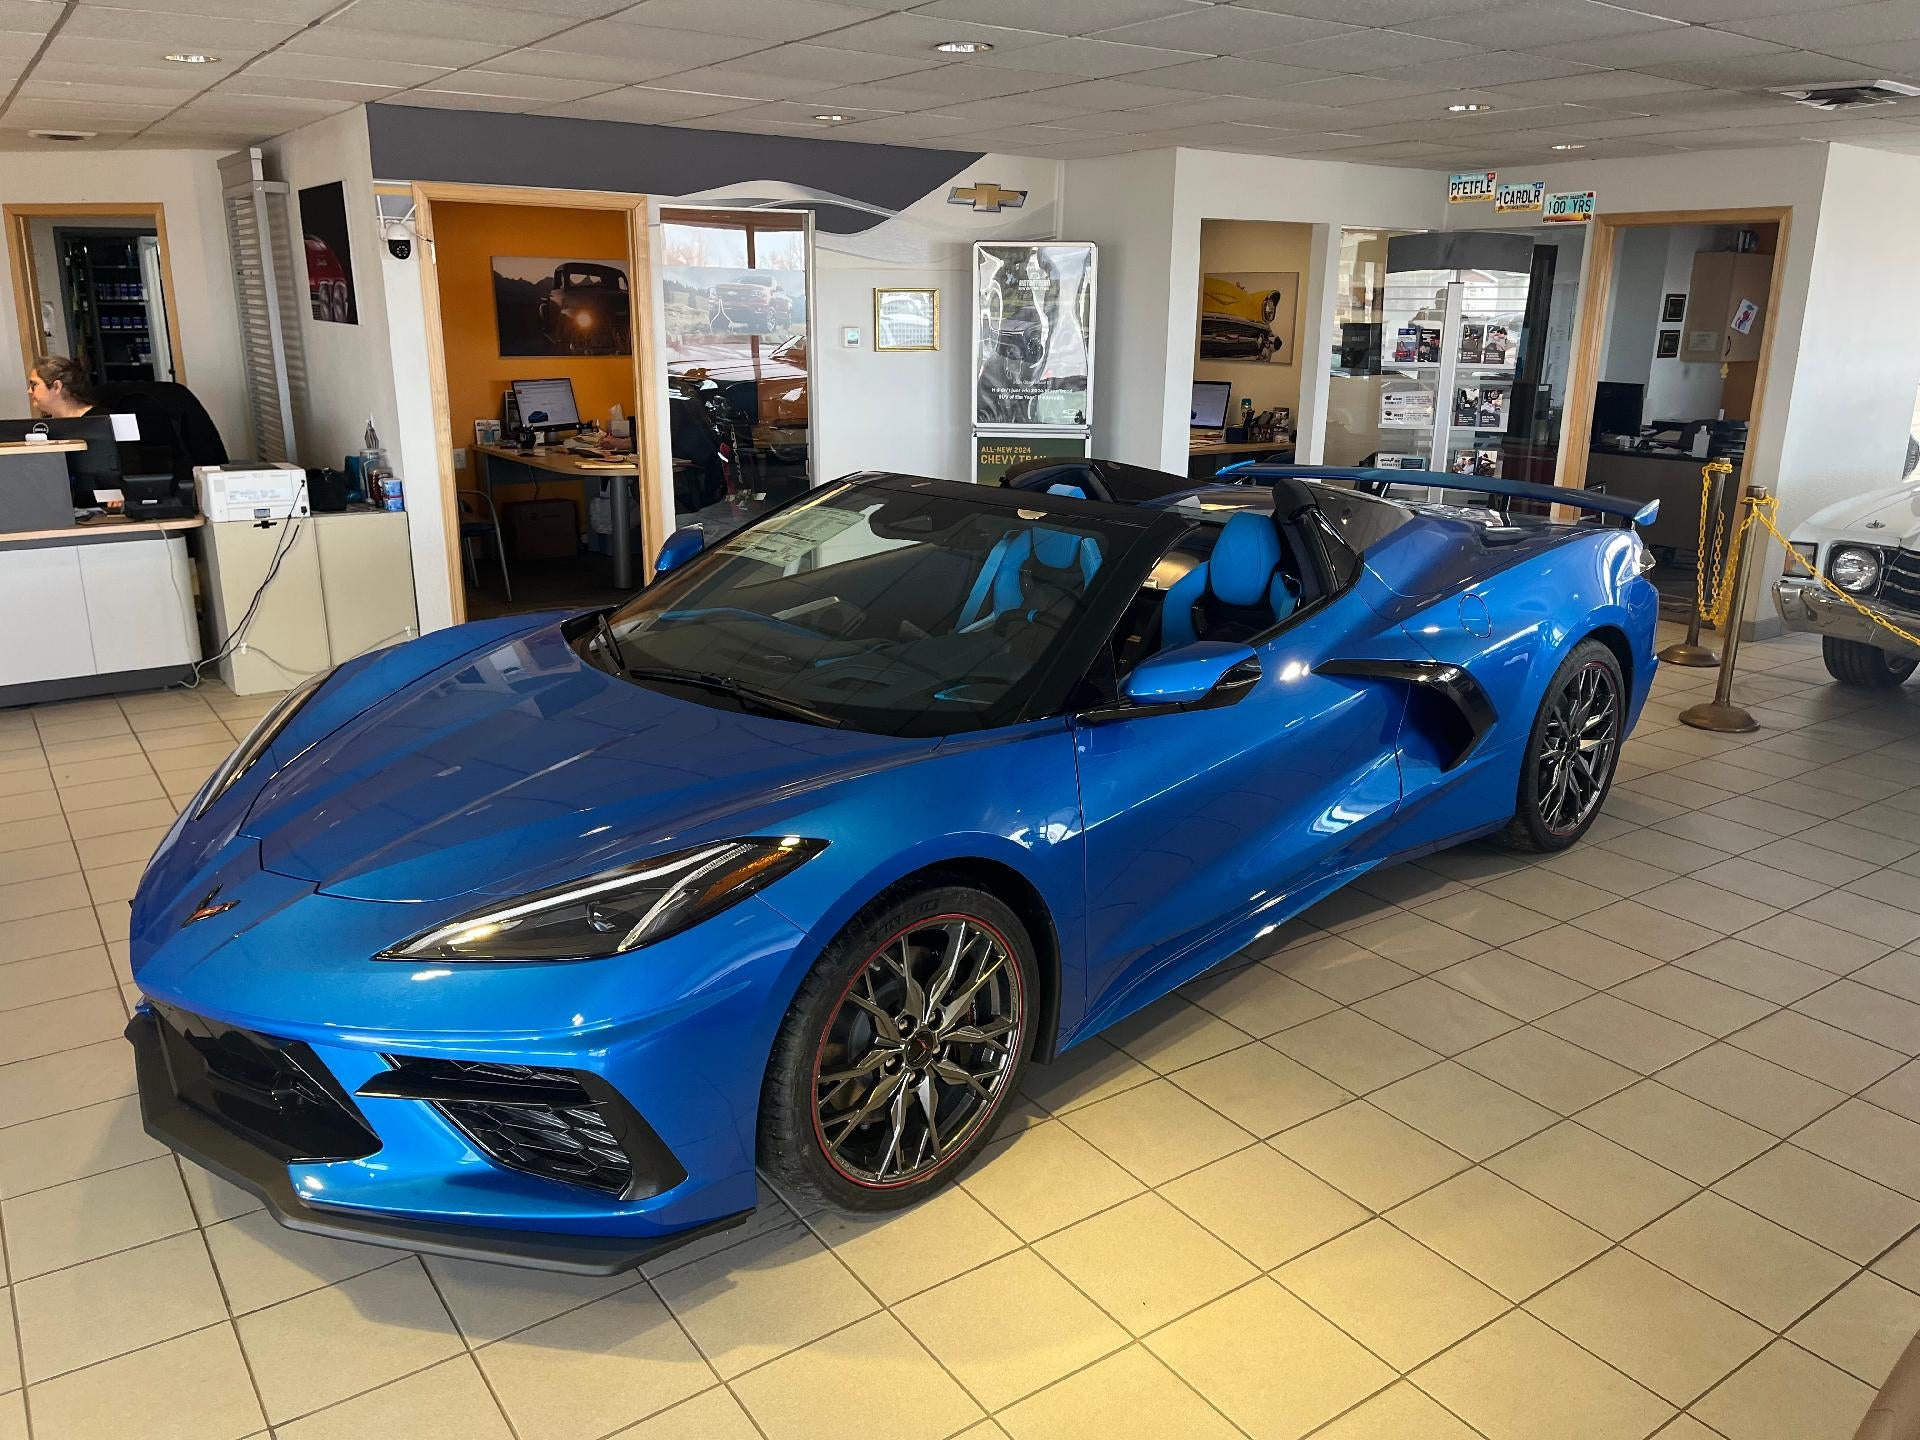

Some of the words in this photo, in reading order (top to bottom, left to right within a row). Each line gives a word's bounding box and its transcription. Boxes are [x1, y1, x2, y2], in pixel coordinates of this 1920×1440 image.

[1451, 180, 1493, 195] PFEIFLE
[1548, 201, 1566, 214] 100
[1573, 199, 1591, 213] YRS
[980, 454, 1016, 465] CHEVY
